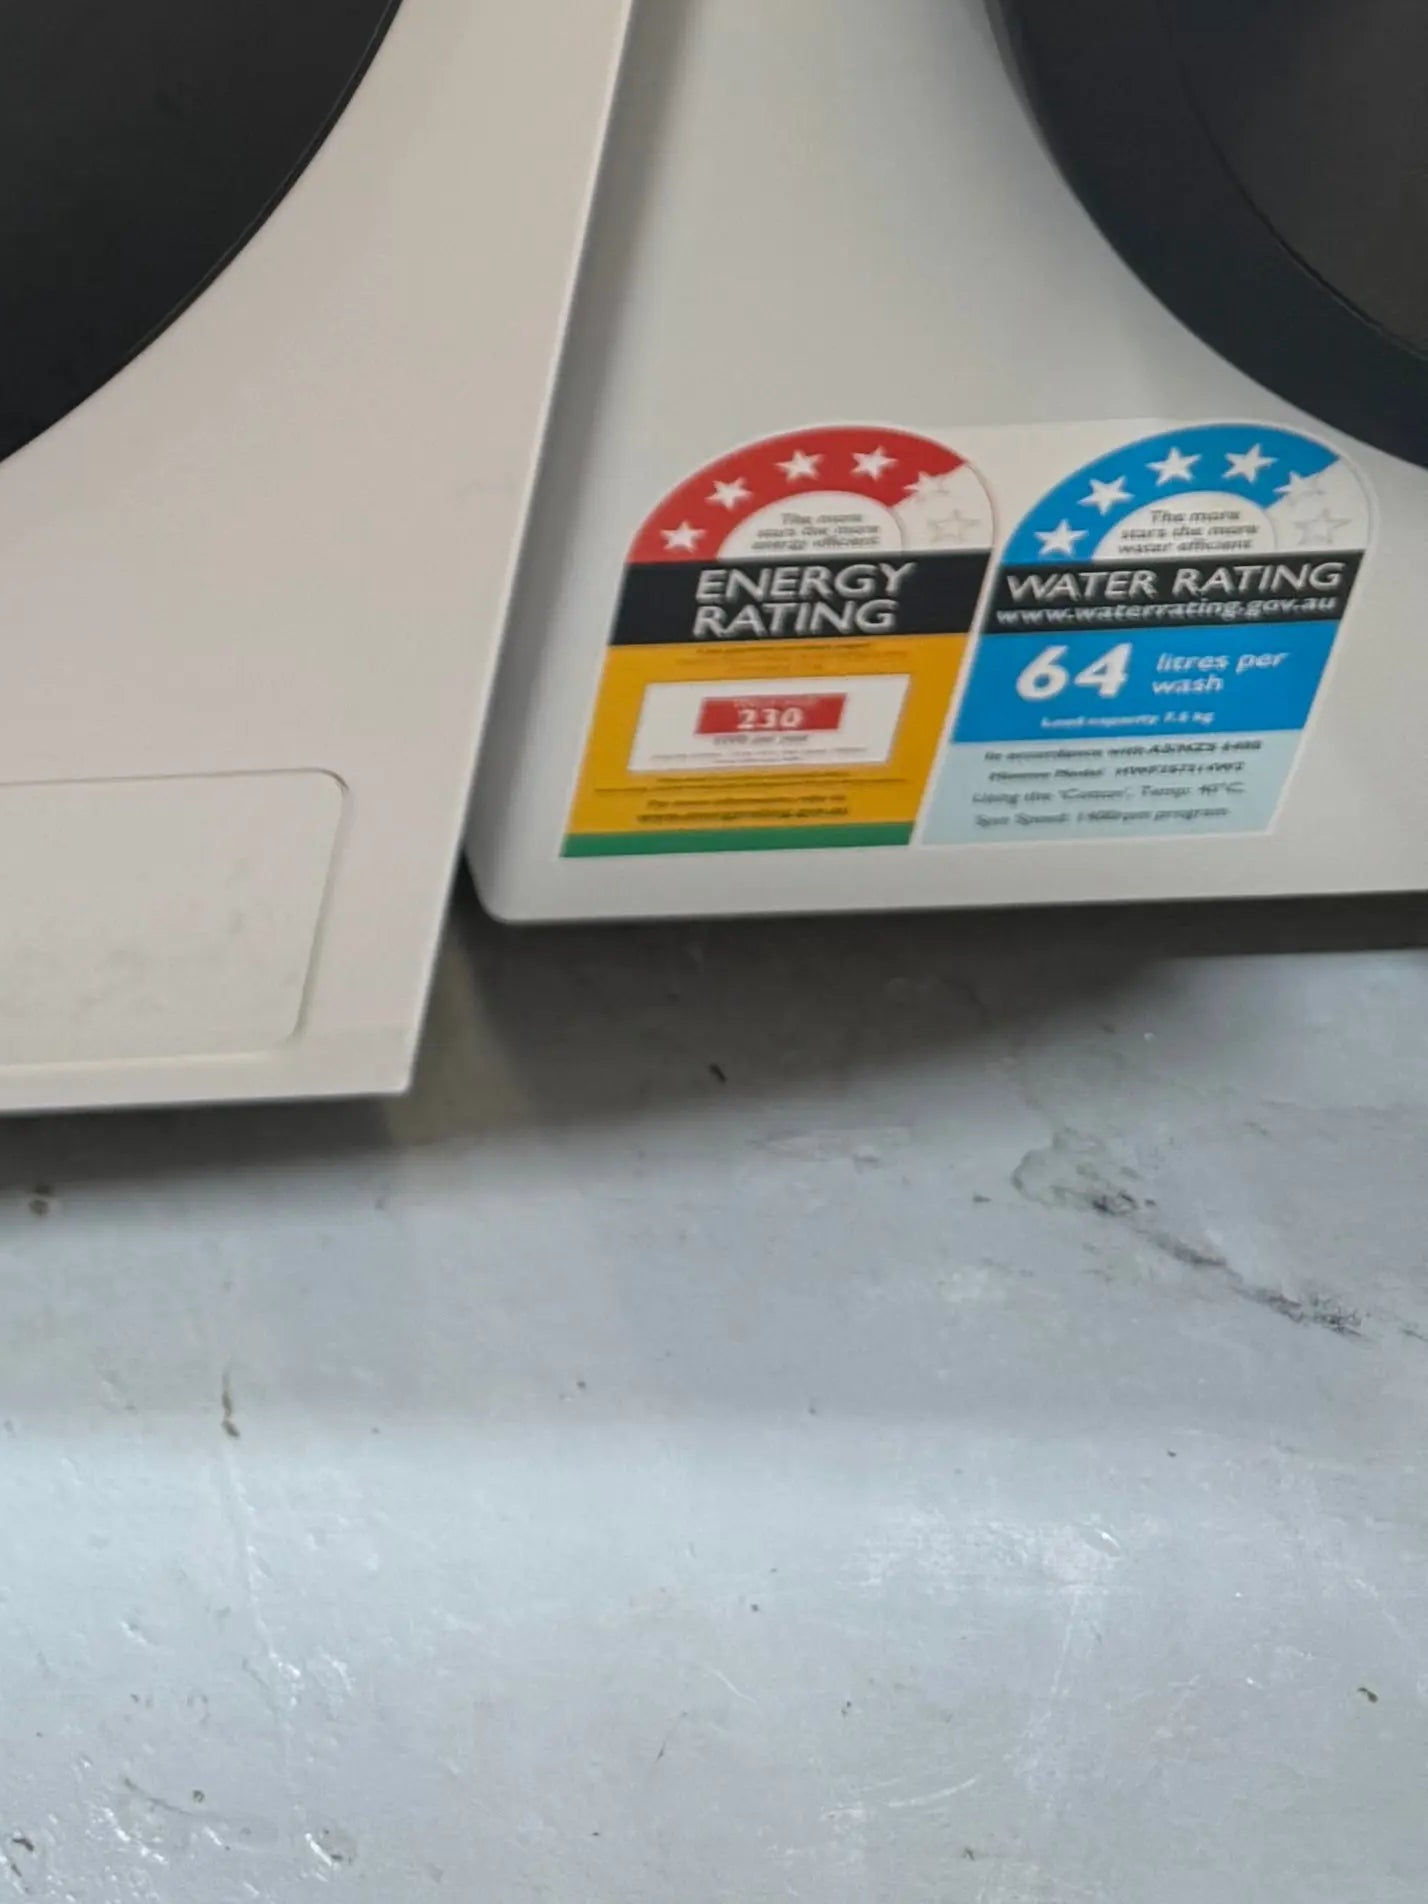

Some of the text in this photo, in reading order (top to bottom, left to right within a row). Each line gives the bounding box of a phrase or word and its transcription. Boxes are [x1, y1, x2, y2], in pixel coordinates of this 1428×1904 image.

[696, 563, 916, 602] ENERGY
[1007, 562, 1346, 602] WATER RATING
[693, 599, 898, 638] RATING
[996, 596, 1337, 624] www.waterrating.gov.au
[1016, 642, 1133, 701] 64
[1156, 652, 1291, 674] litres per
[1152, 673, 1223, 694] wash
